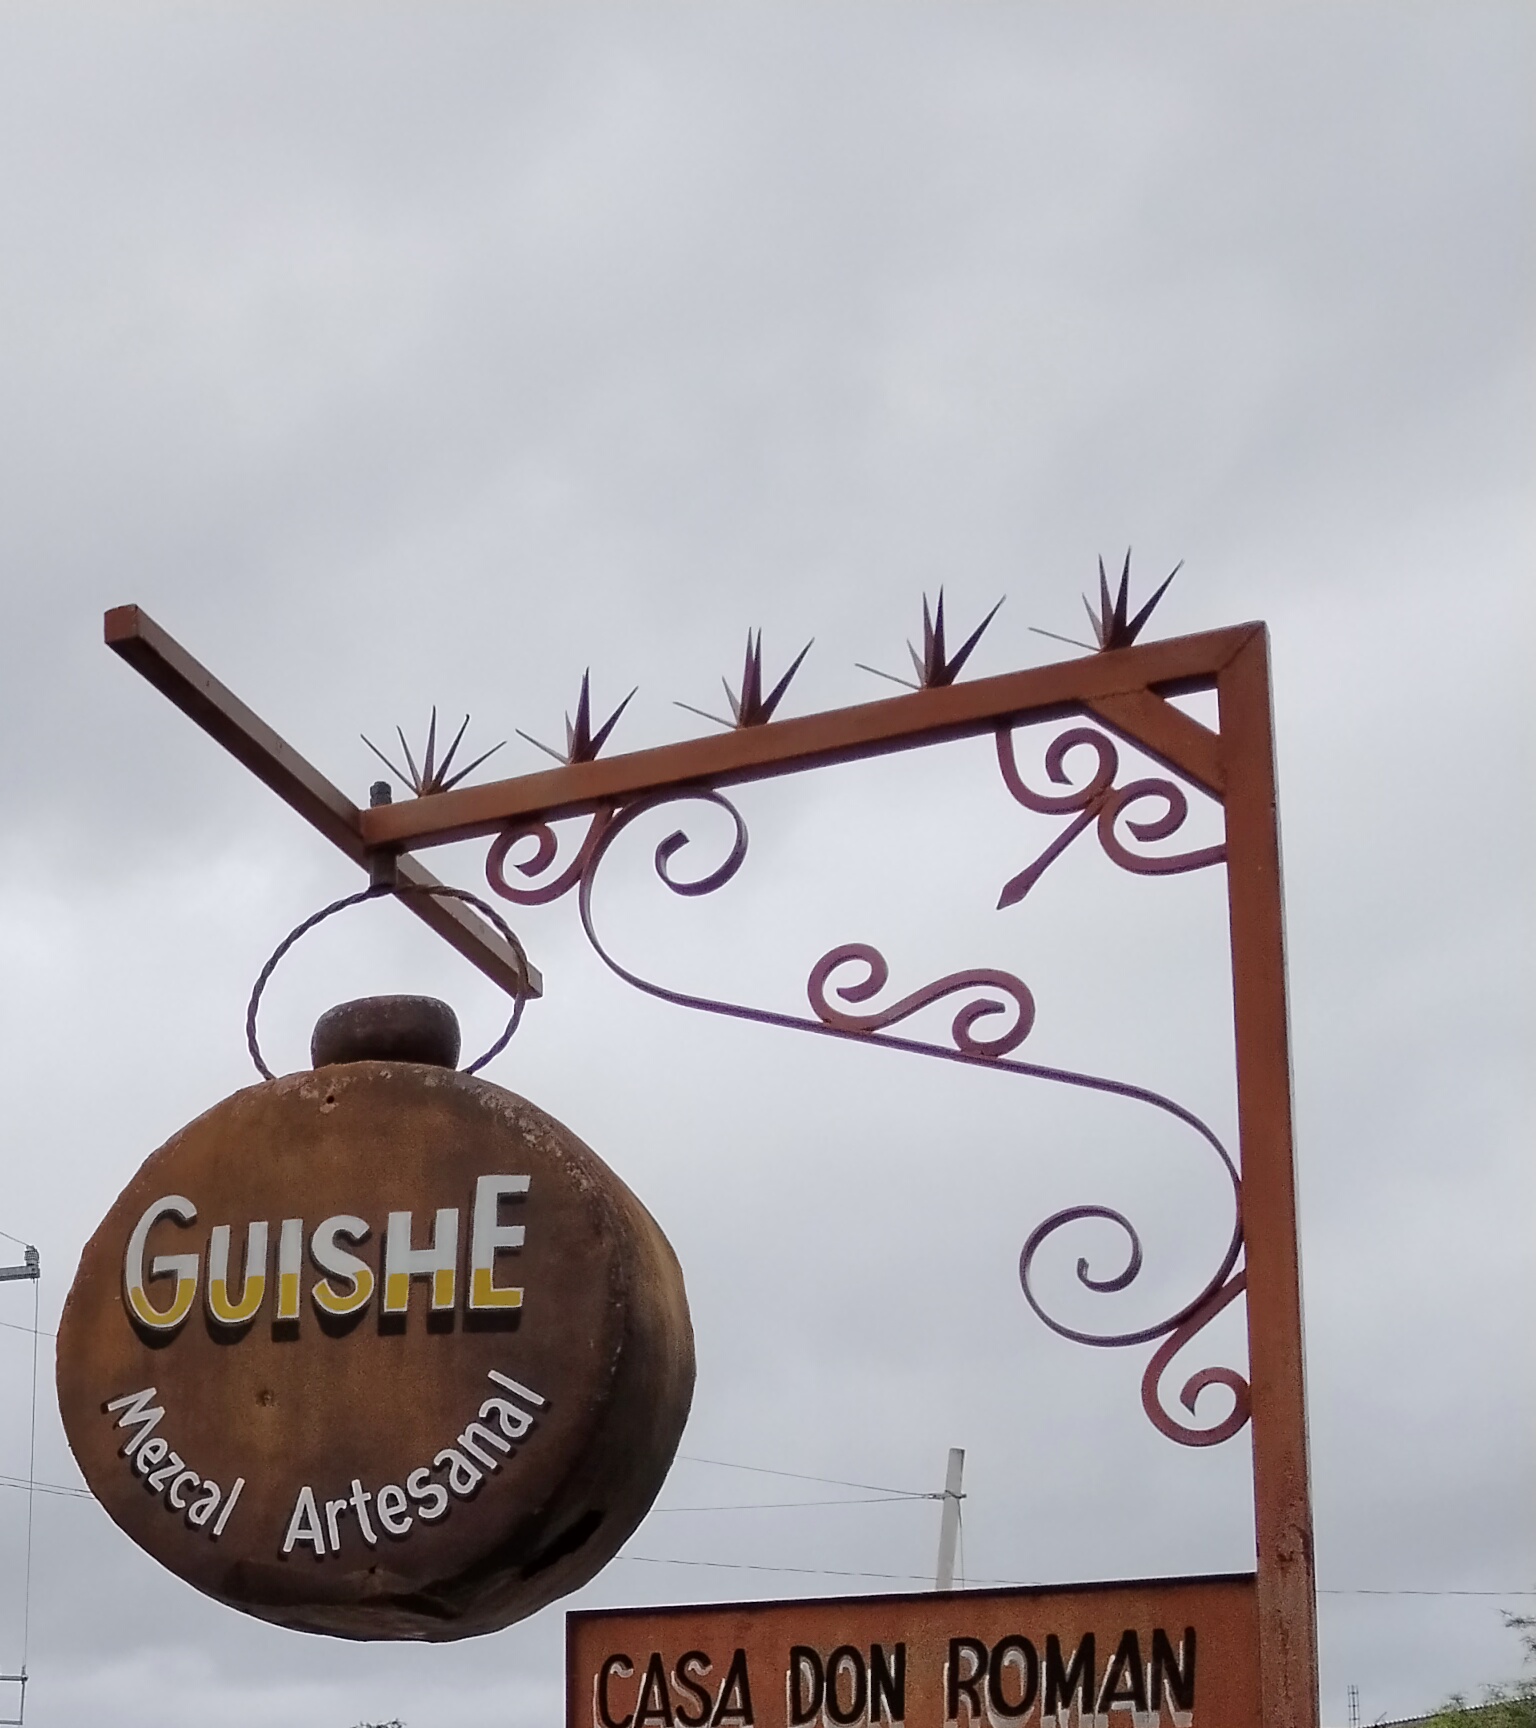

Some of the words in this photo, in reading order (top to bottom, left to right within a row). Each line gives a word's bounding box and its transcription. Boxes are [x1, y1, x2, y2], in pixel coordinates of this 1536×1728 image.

[125, 1174, 532, 1332] GUISHE
[106, 1387, 246, 1538] Mezcal
[281, 1369, 546, 1556] Artesanal
